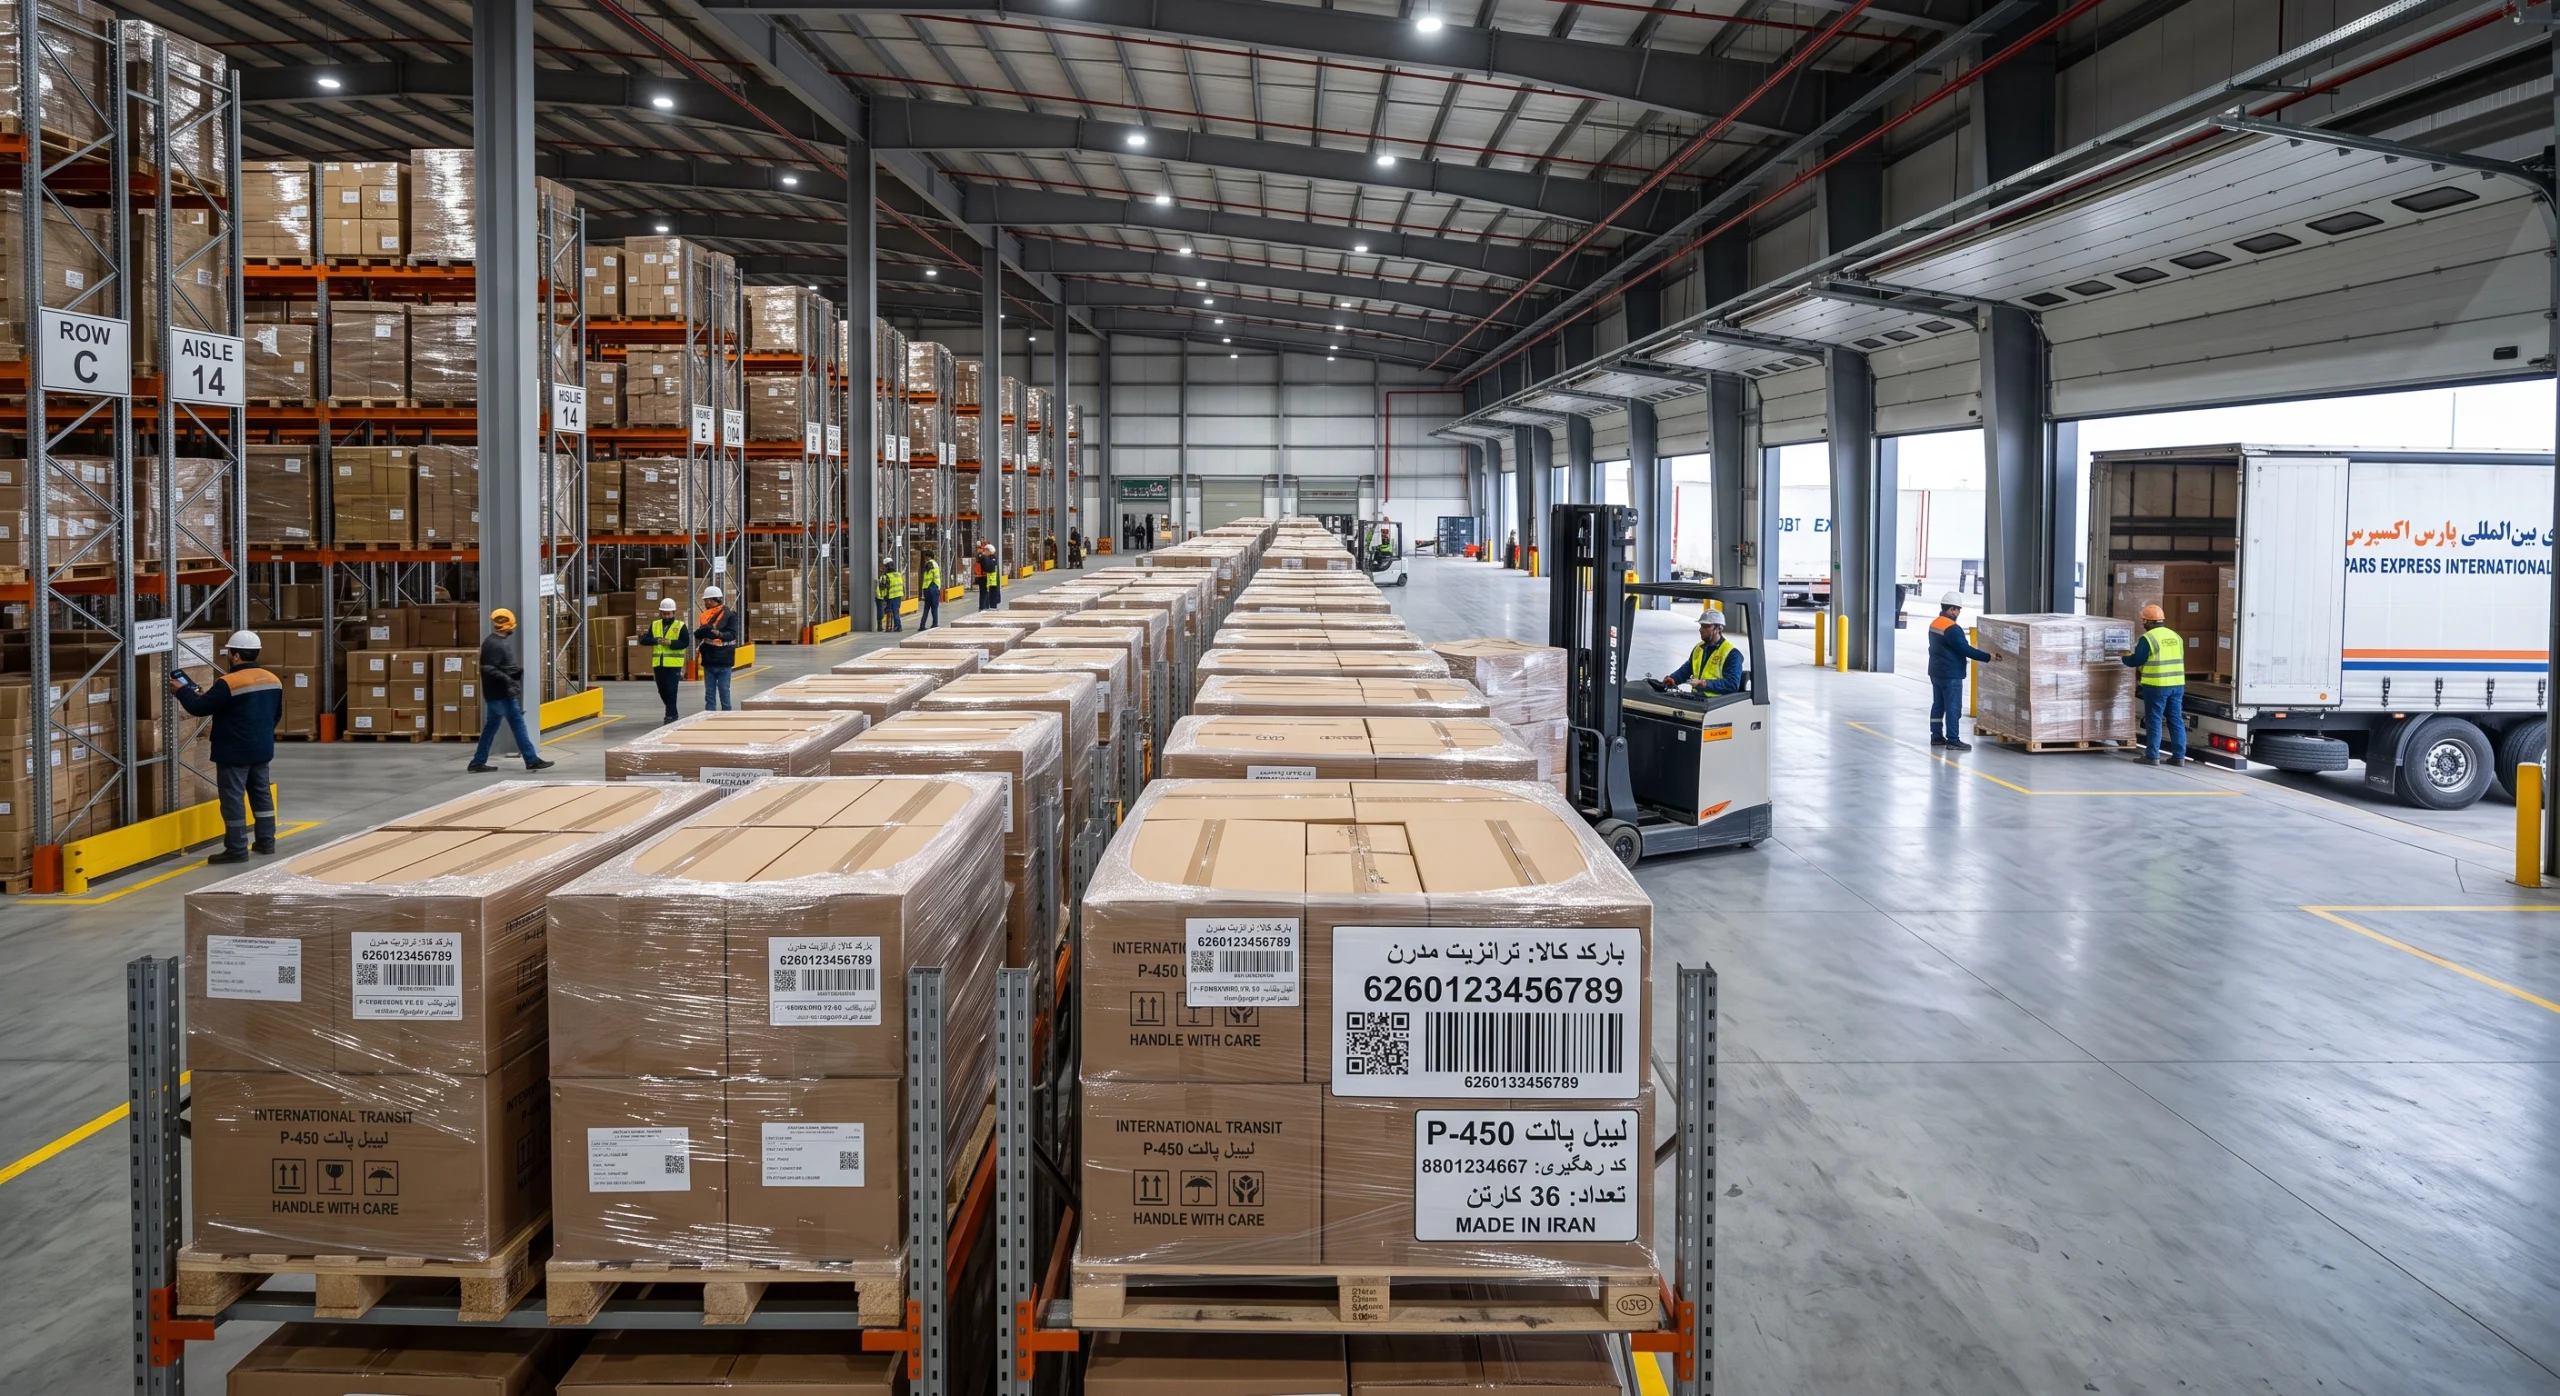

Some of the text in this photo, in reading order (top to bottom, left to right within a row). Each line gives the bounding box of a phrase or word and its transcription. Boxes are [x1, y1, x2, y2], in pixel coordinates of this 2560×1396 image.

[60, 320, 111, 345] ROW
[181, 339, 234, 362] AISLE
[74, 350, 99, 384] C
[193, 364, 226, 396] 14
[563, 406, 578, 427] 14
[2347, 519, 2410, 547] اکسپرس
[2414, 519, 2457, 548] پارس
[2345, 557, 2552, 575] PARS EXPRESS INTERNATIONAL
[1197, 936, 1291, 947] 6260123456789
[362, 949, 452, 961] 6260123456789
[780, 954, 873, 966] 6260123456789
[1387, 941, 1625, 966] بارکد کالا: ترانزیت مدرن
[1138, 963, 1178, 978] P-450
[1364, 975, 1623, 1004] 6260123456789
[1130, 1033, 1261, 1047] HANDLE WITH CARE
[1464, 1076, 1579, 1090] 6260133456789
[254, 1109, 413, 1124] INTERNATIONAL TRANSIT
[1116, 1120, 1283, 1134] INTERNATIONAL TRANSIT
[280, 1131, 319, 1145] P-450
[323, 1130, 353, 1150] پالت
[1427, 1118, 1628, 1153] لیبل پالت P-450
[1143, 1142, 1184, 1156] P-450
[1188, 1141, 1219, 1162] پالت
[1422, 1158, 1528, 1174] 8801234667
[1610, 1158, 1627, 1172] کد
[1466, 1185, 1626, 1209] تعداد: 36 کارتن
[272, 1201, 399, 1215] HANDLE WITH CARE
[1133, 1212, 1265, 1226] HANDLE WITH CARE
[1456, 1217, 1596, 1233] MADE IN IRAN
